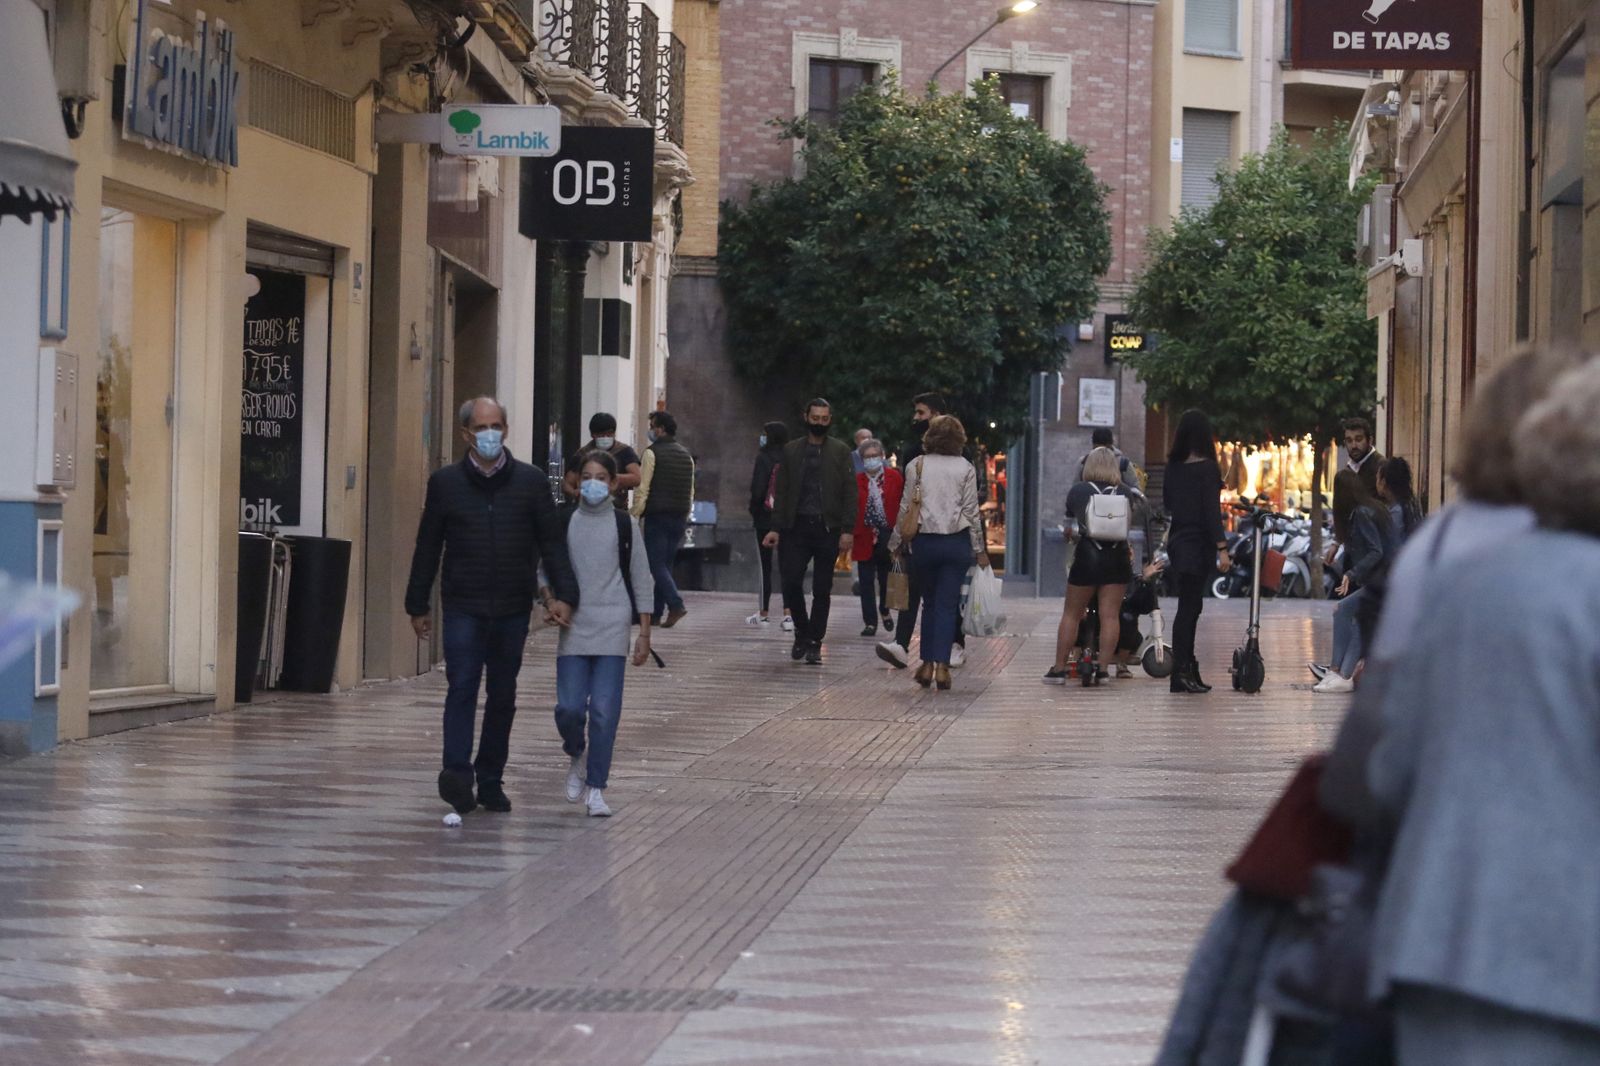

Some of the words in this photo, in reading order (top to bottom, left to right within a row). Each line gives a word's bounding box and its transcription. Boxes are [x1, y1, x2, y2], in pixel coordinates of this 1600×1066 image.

[1333, 31, 1365, 50] DE
[1372, 31, 1451, 50] TAPAS
[129, 0, 240, 168] Lambik
[477, 130, 550, 150] Lambik
[553, 158, 616, 206] OB
[623, 161, 631, 206] cocinas
[247, 318, 284, 340] TAPAS
[241, 420, 252, 435] EN
[255, 420, 281, 438] CARTA
[240, 498, 283, 523] bik
